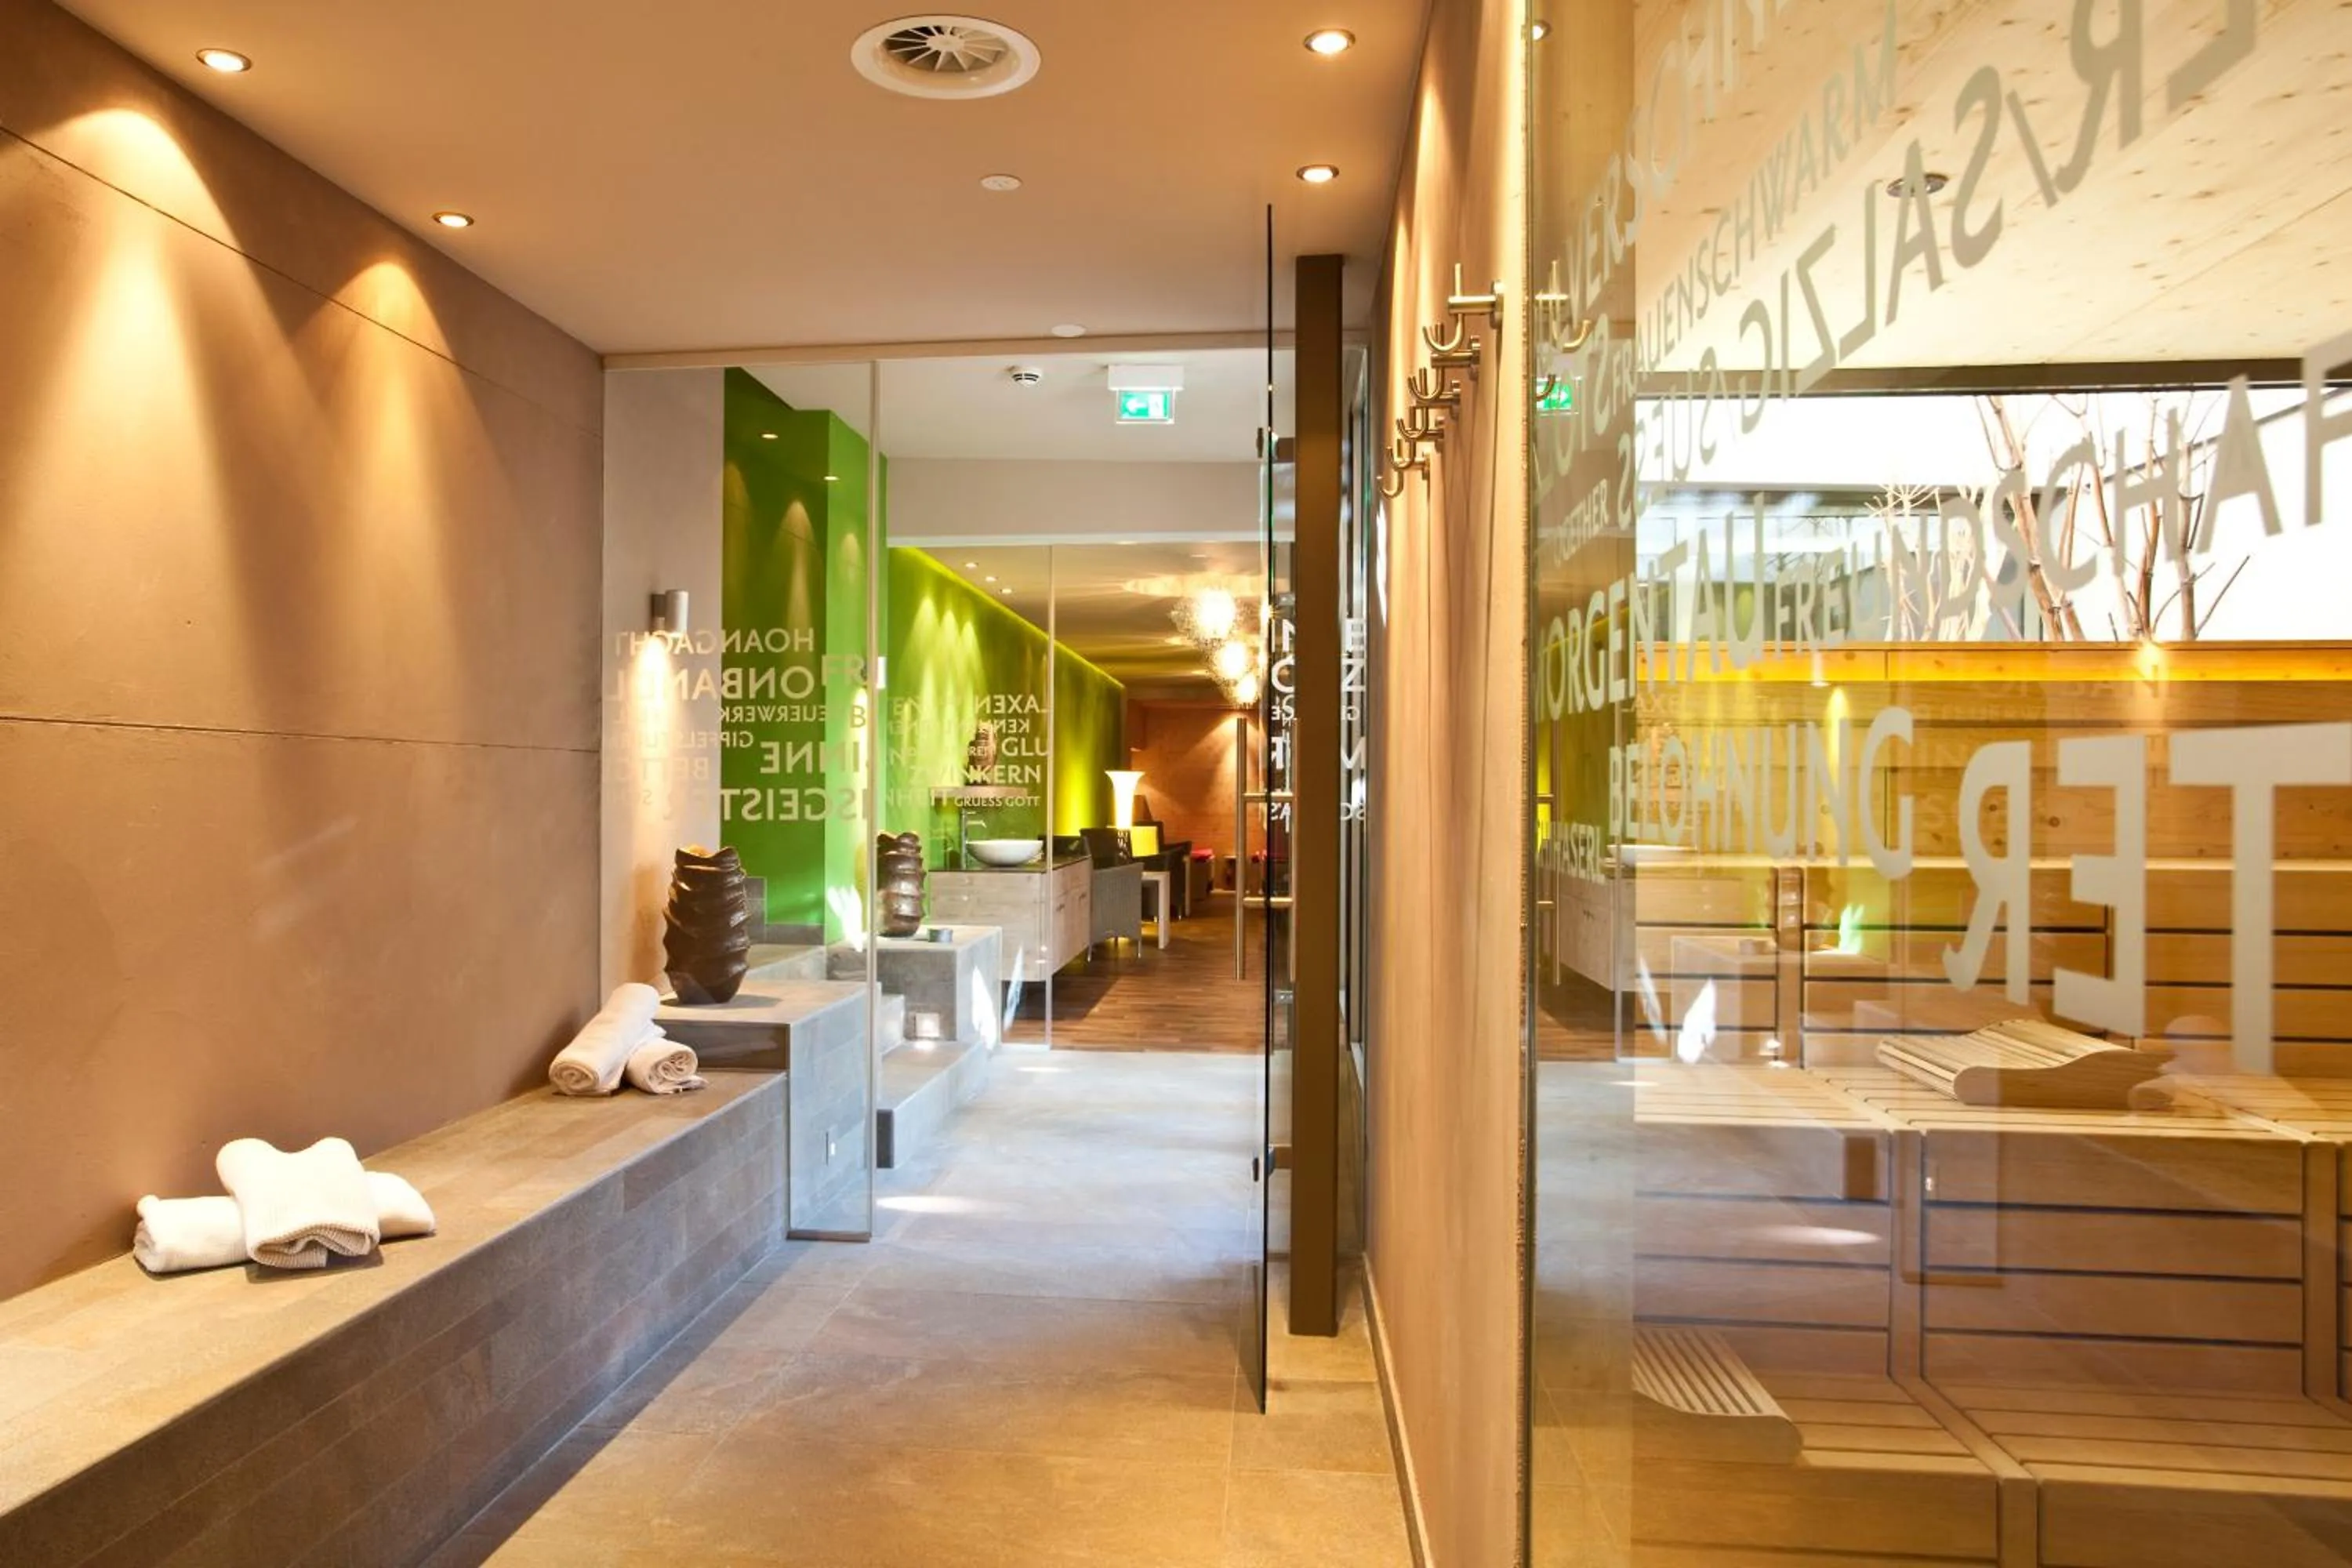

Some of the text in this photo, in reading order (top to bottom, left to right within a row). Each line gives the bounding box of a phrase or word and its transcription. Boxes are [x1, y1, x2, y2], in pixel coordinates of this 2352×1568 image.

[1612, 0, 1899, 416] FRAUENSCHWARM
[954, 795, 1042, 808] GRUESS GOTT
[1607, 707, 1915, 880] BELOHNUNG
